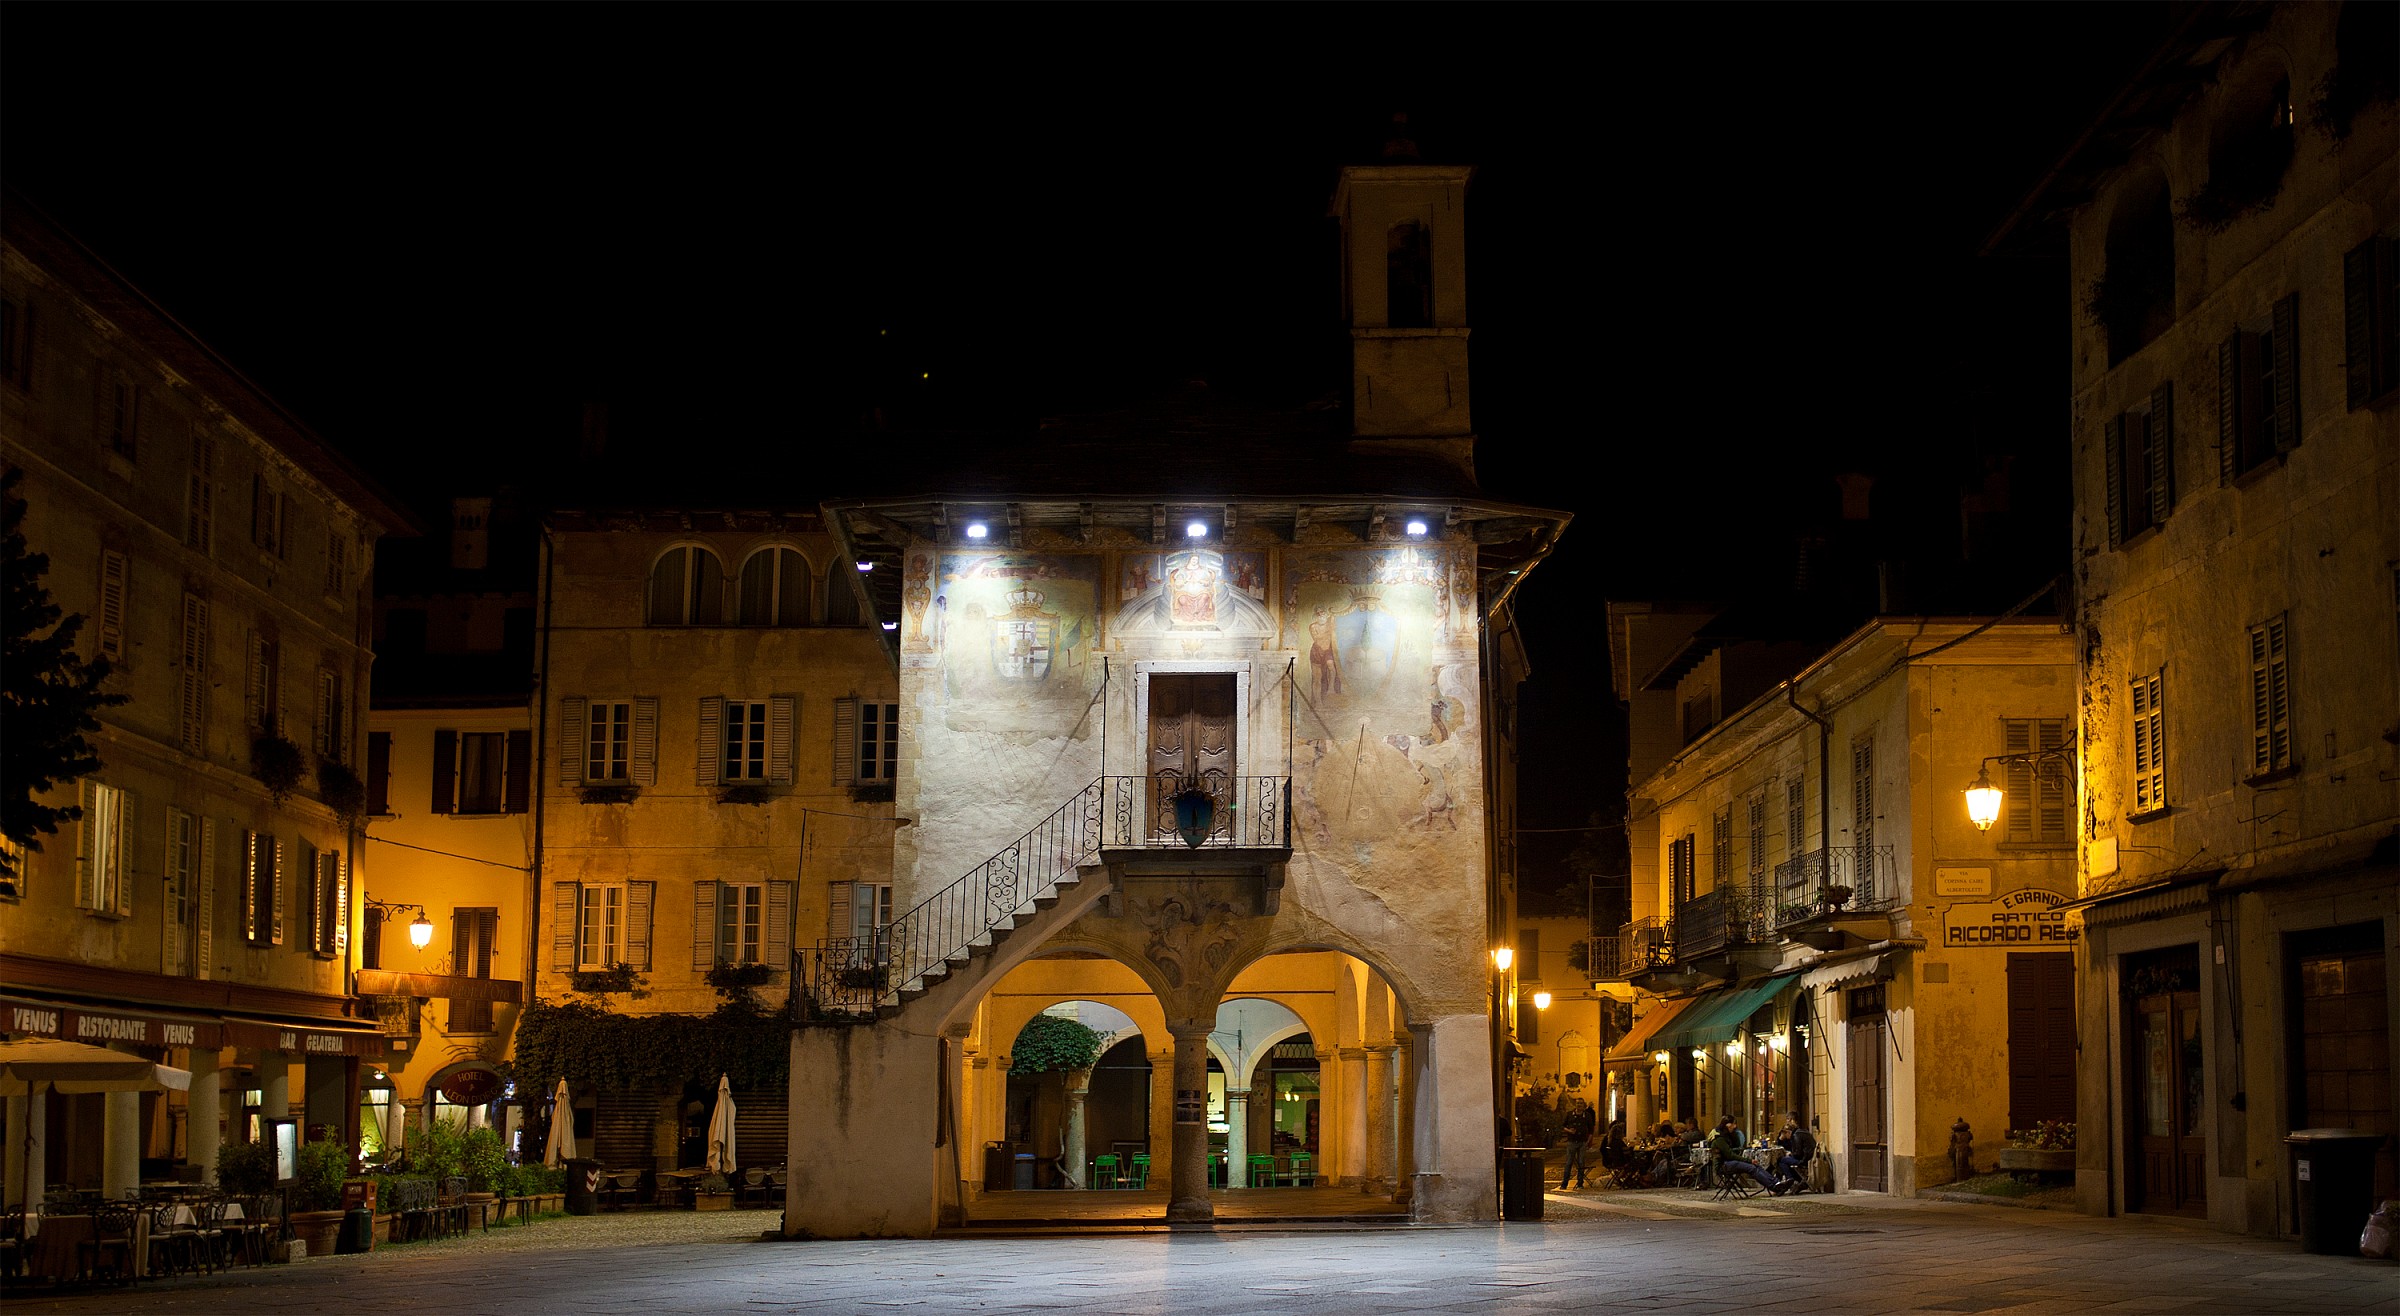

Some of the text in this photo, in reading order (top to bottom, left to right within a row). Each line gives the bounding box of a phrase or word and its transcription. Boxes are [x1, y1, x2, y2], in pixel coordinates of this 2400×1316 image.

[1949, 926, 2031, 942] RICORDO
[13, 1008, 57, 1033] VENUS
[78, 1016, 195, 1045] RISTORANTE VENUS
[280, 1032, 343, 1052] BAR GELATERIA
[458, 1071, 484, 1082] HOTEL
[445, 1088, 470, 1104] LEON
